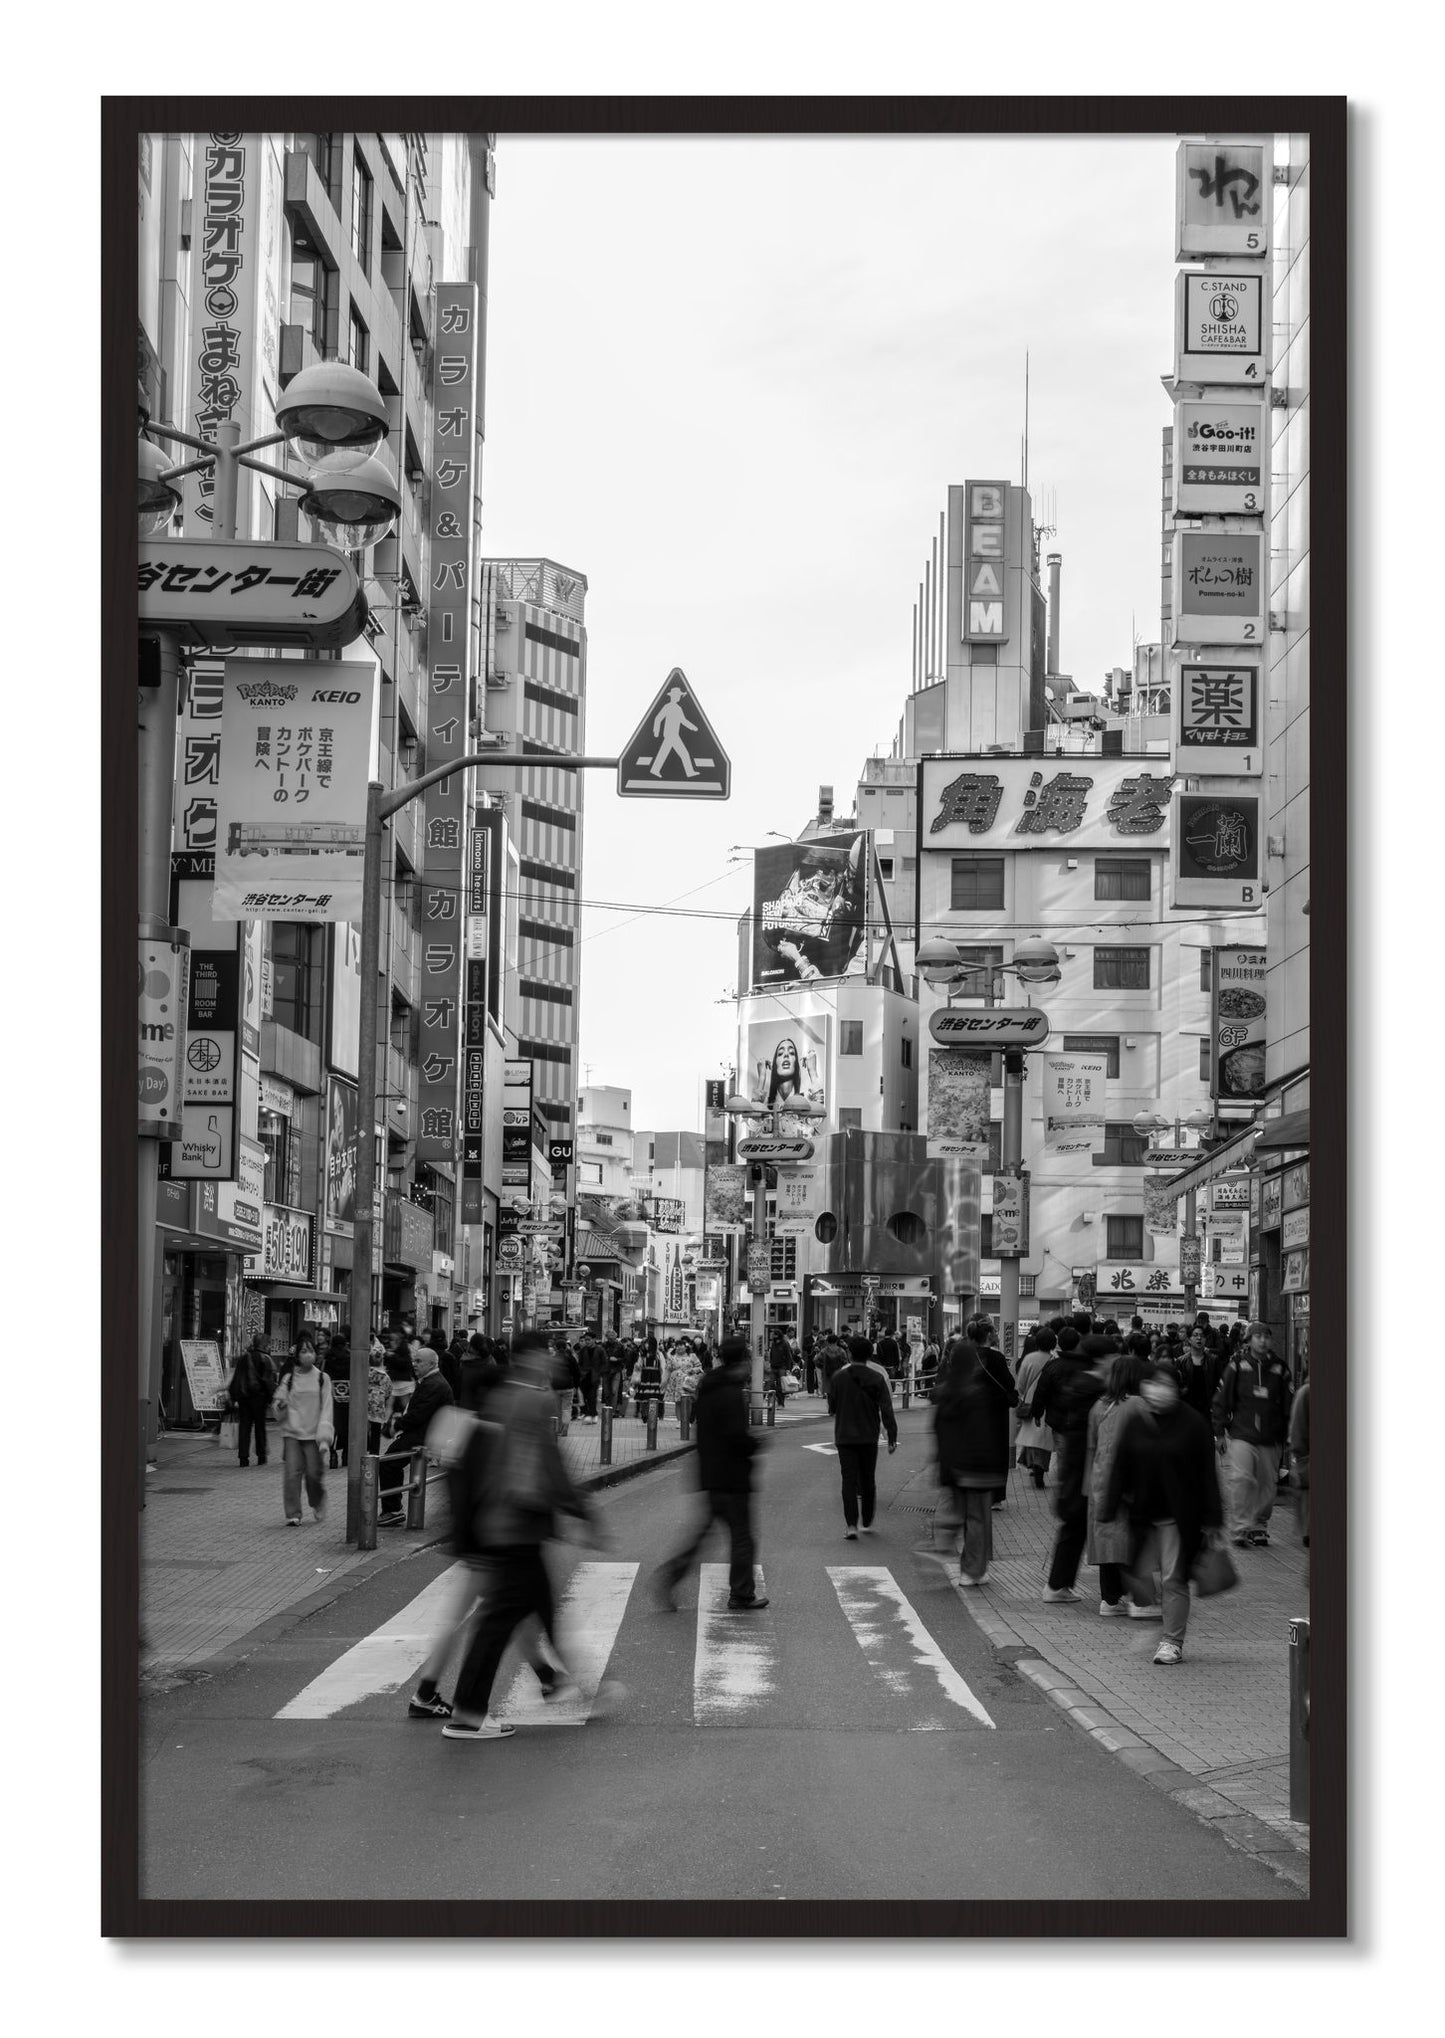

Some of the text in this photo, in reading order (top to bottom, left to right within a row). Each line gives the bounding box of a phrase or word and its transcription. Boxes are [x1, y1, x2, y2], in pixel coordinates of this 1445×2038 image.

[202, 146, 244, 288] カラオケ
[1246, 233, 1259, 249] 5
[1201, 281, 1247, 292] C.STAND
[1201, 323, 1246, 334] SHISHA
[1201, 334, 1246, 343] CAFE&BAR
[1245, 362, 1257, 379] 4
[1199, 423, 1255, 440] Goo-it!
[1187, 469, 1256, 481] 全身もみほぐし
[1244, 492, 1256, 509] 3
[970, 484, 1005, 634] BEAM
[1188, 565, 1254, 586] ポムの樹
[1243, 623, 1255, 639] 2
[249, 697, 286, 707] KANTO
[311, 689, 361, 704] KEIO
[1191, 673, 1243, 725] 薬
[1186, 727, 1249, 743] マツモトキヨシ
[254, 726, 271, 771] 冒険へ
[273, 726, 292, 804] カントーの
[315, 727, 334, 789] 京王線で
[1243, 755, 1252, 771] 1
[930, 772, 1177, 834] 角海老
[1186, 812, 1248, 861] 一蘭
[473, 833, 483, 910] kimono hearts
[241, 893, 333, 907] 渋谷センター街
[1241, 886, 1254, 903] B
[195, 970, 217, 978] THIRD
[199, 962, 214, 970] THE
[194, 999, 217, 1007] ROOM
[198, 1010, 213, 1018] BAR
[937, 1017, 1042, 1031] 渋谷センター街
[146, 1076, 167, 1091] Day!
[182, 1143, 216, 1154] Whisky
[551, 1146, 571, 1157] GU
[741, 1143, 806, 1153] 渋谷センター街
[182, 1152, 202, 1161] Bank
[672, 1266, 681, 1310] BEER
